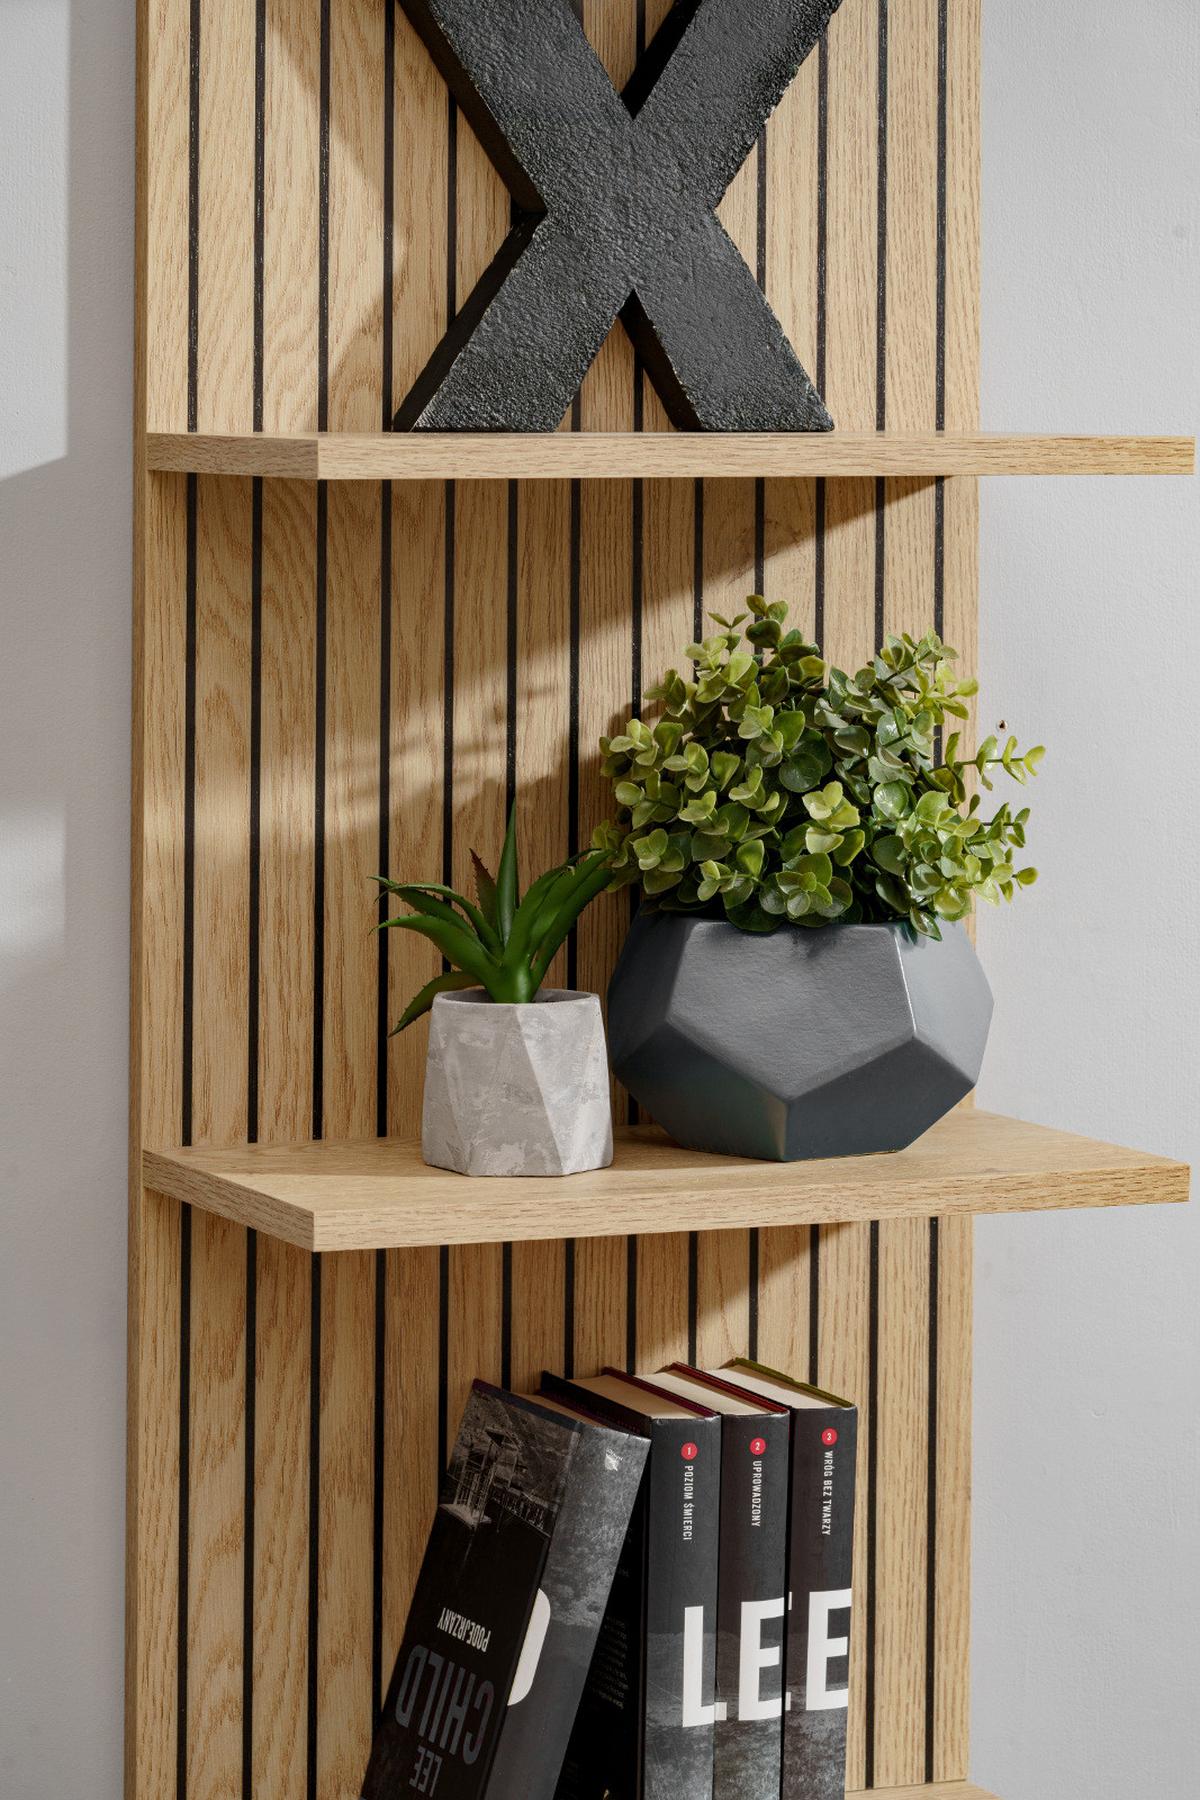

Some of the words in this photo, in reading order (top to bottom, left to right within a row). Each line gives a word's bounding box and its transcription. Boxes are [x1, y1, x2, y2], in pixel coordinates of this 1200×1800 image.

[683, 1465, 694, 1500] POZIOM
[823, 1450, 834, 1477] WRÓG
[751, 1460, 763, 1527] UPROWADZONY
[823, 1479, 833, 1497] BEZ
[682, 1502, 695, 1541] ŚMIERCI
[821, 1499, 832, 1536] TWARZY
[437, 1607, 492, 1653] PODEJRZANY
[395, 1644, 495, 1765] CHILD
[408, 1745, 443, 1798] LEE
